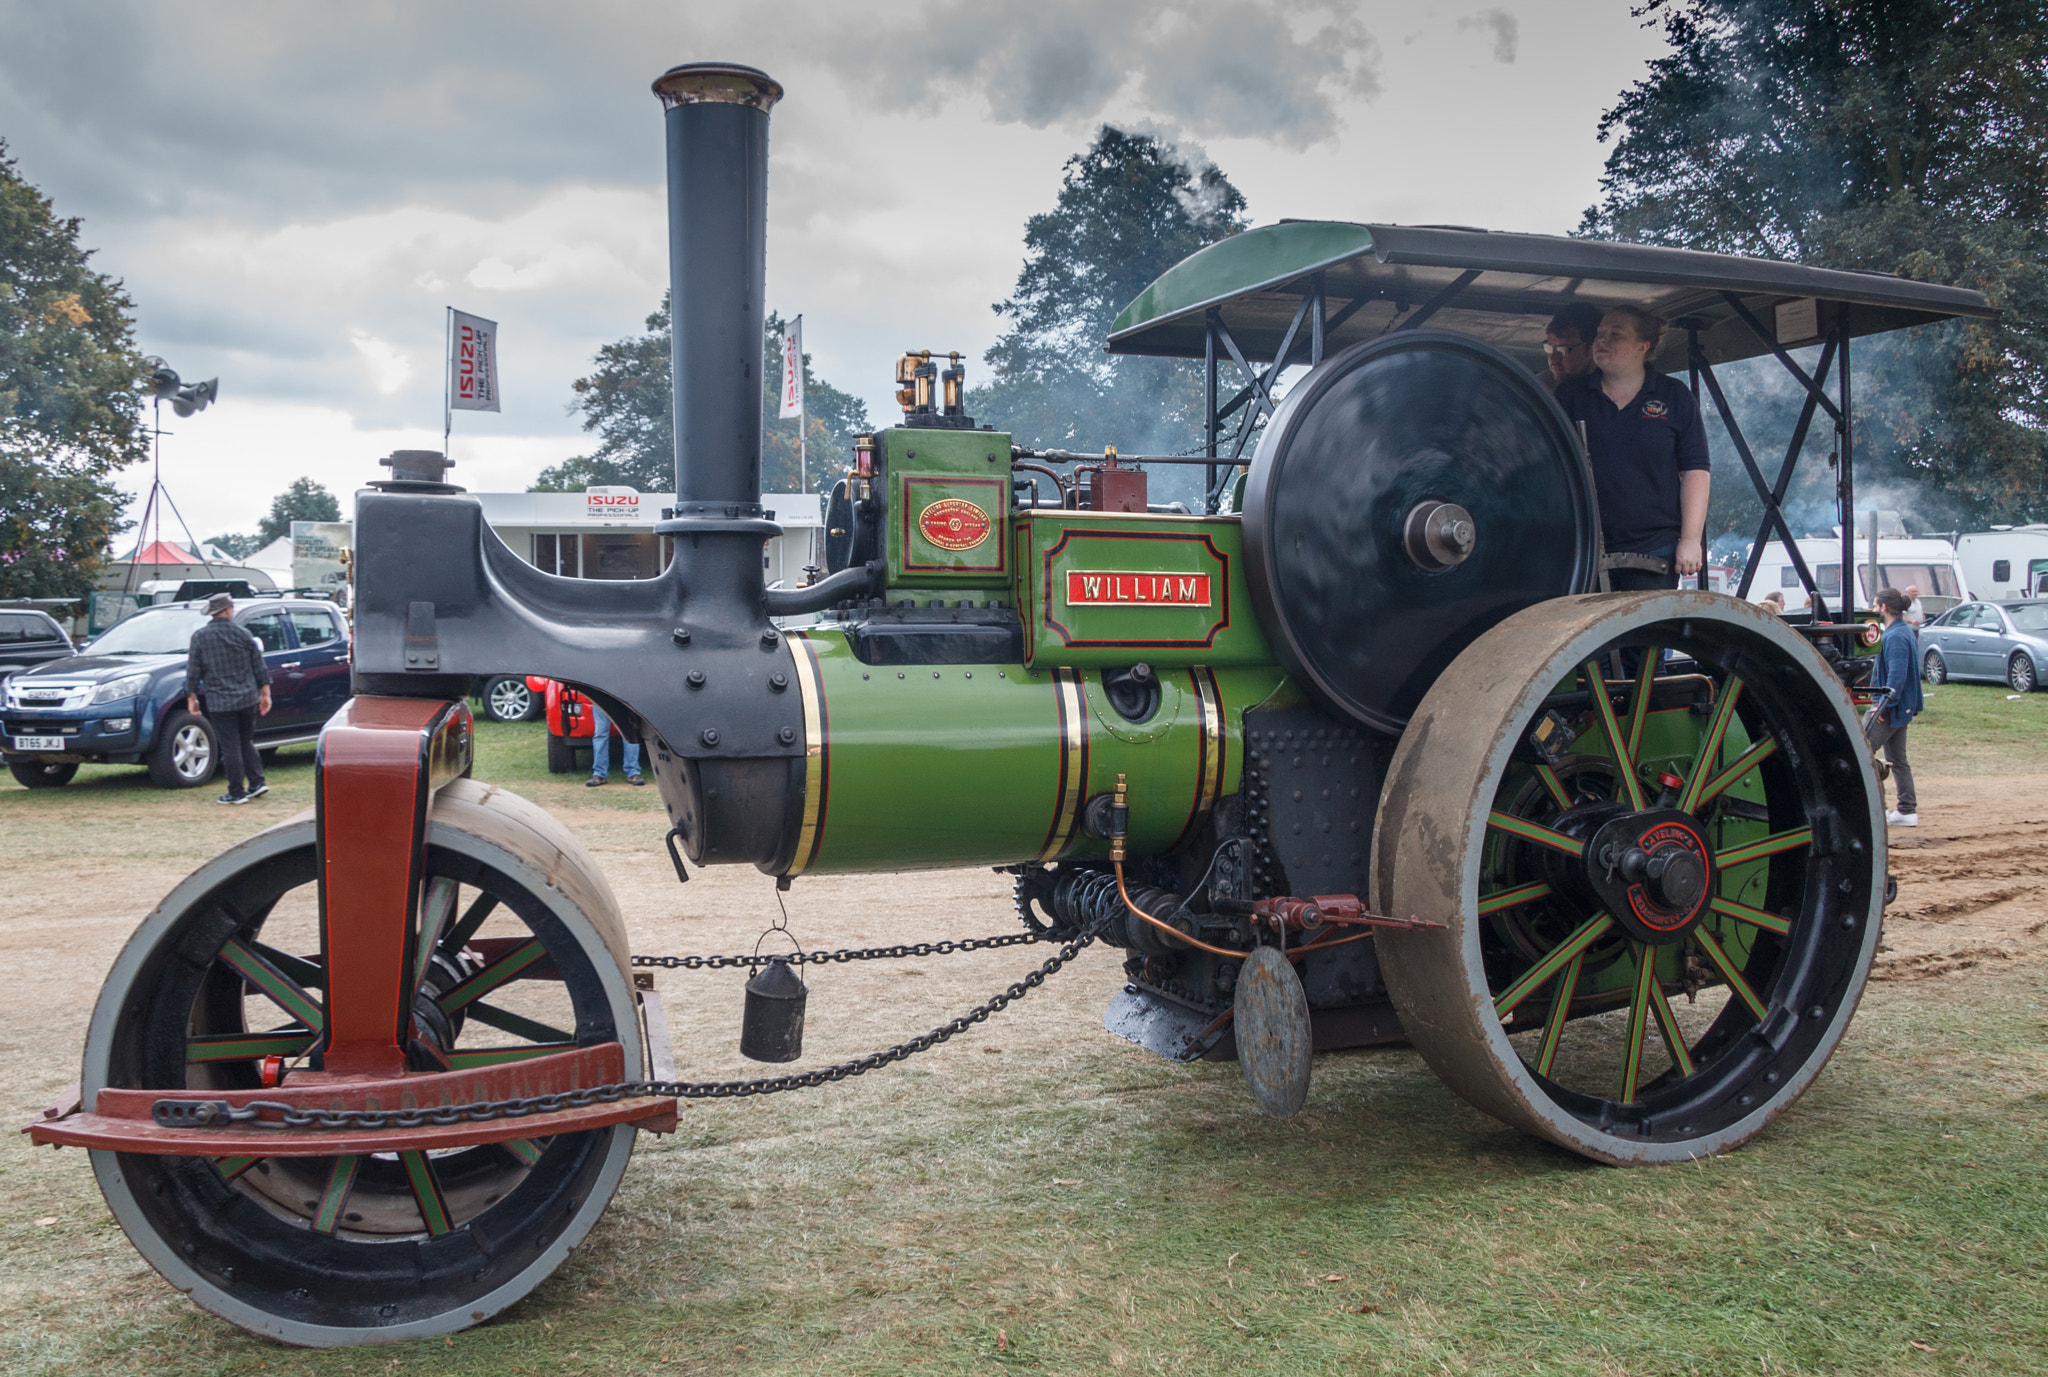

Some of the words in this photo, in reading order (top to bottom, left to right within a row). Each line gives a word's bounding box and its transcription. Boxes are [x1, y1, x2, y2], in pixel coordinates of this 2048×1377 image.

[459, 325, 474, 399] ISUZU
[476, 329, 485, 374] PICK-UP
[786, 337, 794, 408] ISUZU
[477, 377, 485, 400] THE
[587, 495, 639, 505] ISUZU
[1082, 576, 1197, 601] WILLIAM
[1649, 828, 1686, 846] AVELING
